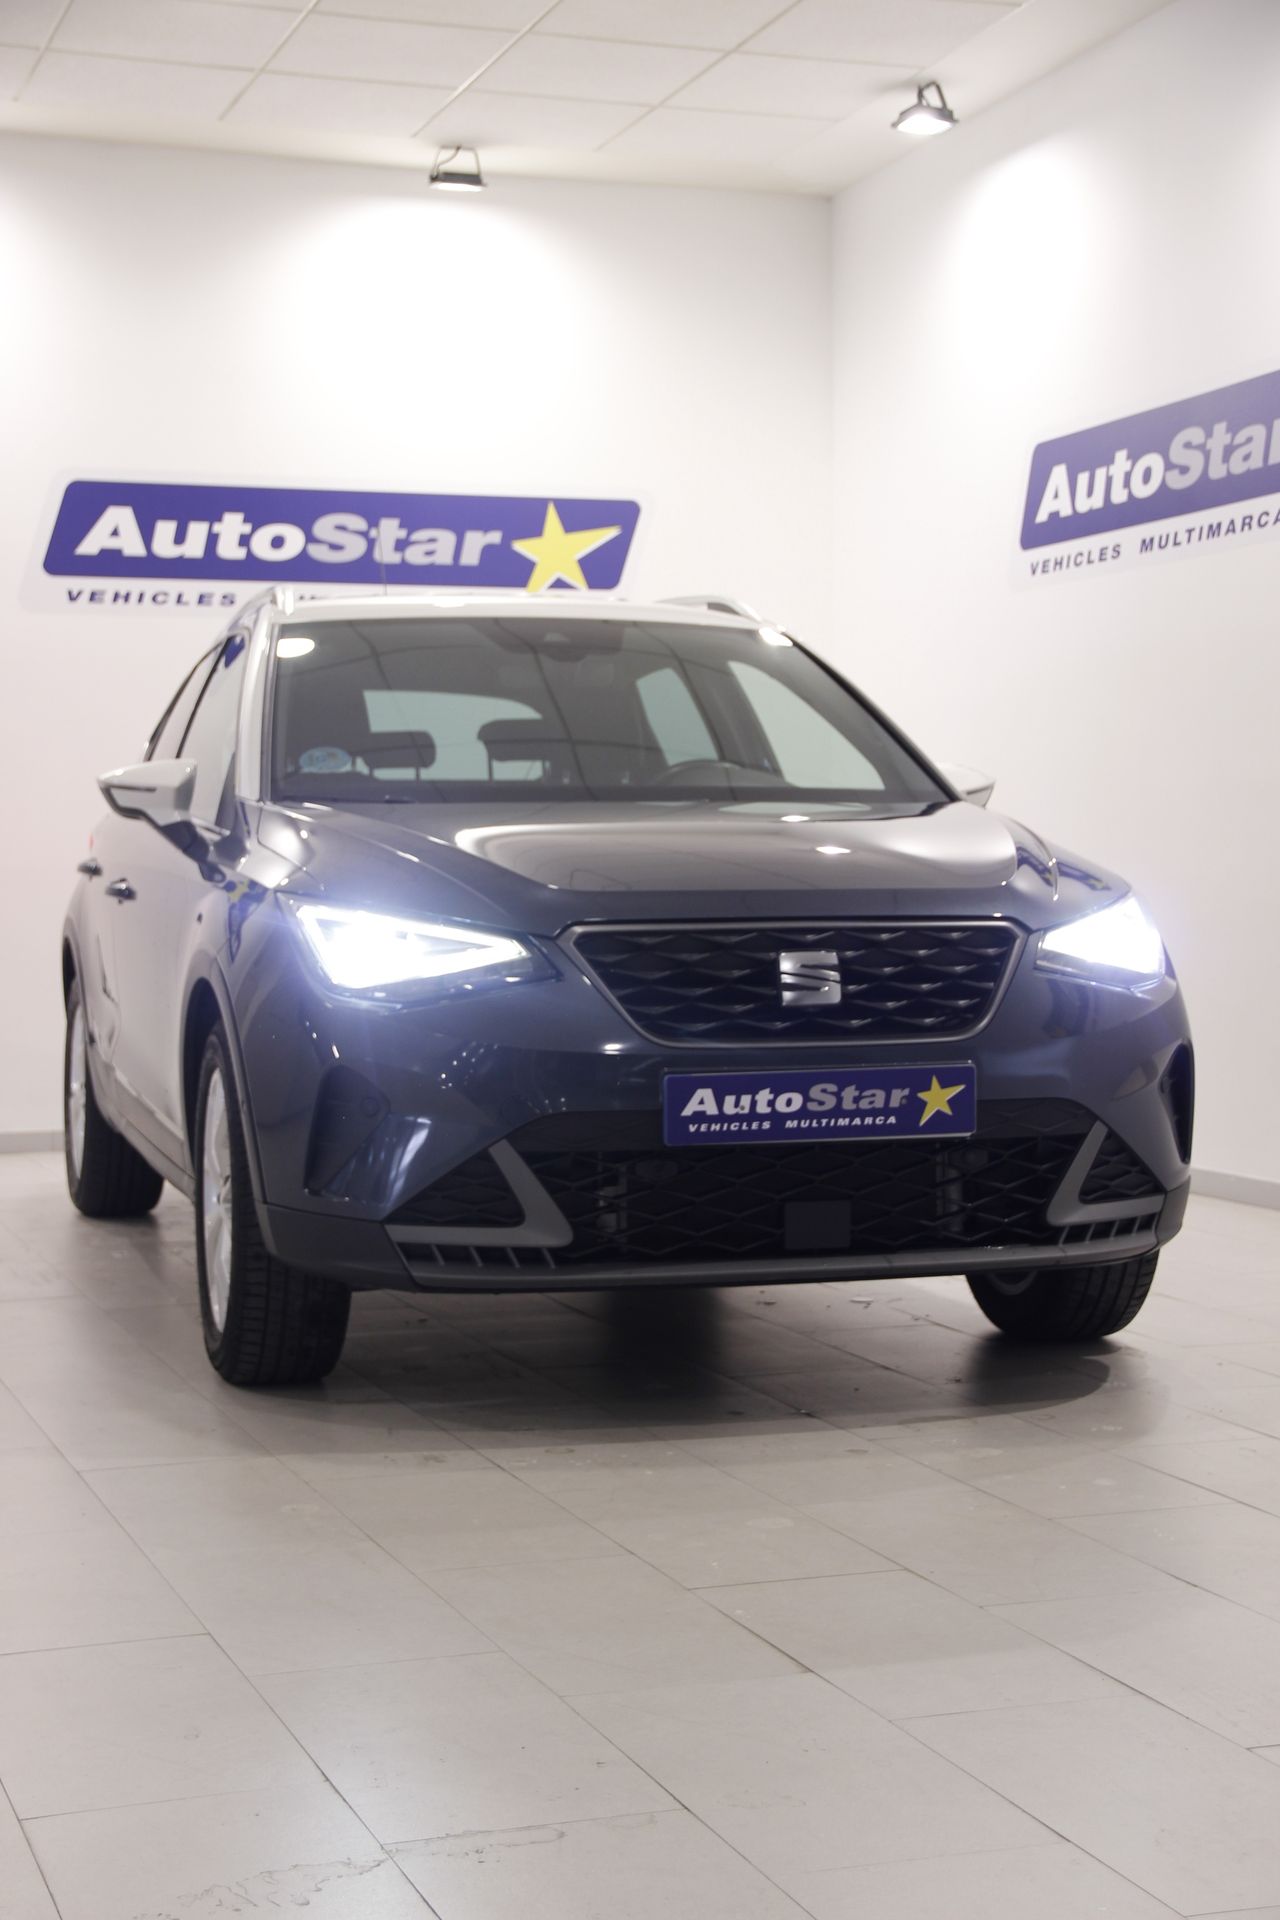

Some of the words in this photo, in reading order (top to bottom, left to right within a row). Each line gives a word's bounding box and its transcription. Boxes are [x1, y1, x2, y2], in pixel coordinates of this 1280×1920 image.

[74, 505, 502, 566] AutoStar
[1030, 544, 1121, 576] VEHICLES
[67, 590, 236, 606] VEHICLES
[680, 1083, 910, 1117] AutoStar
[689, 1121, 772, 1133] VEHICLES
[785, 1116, 896, 1129] MULTIMARCA
